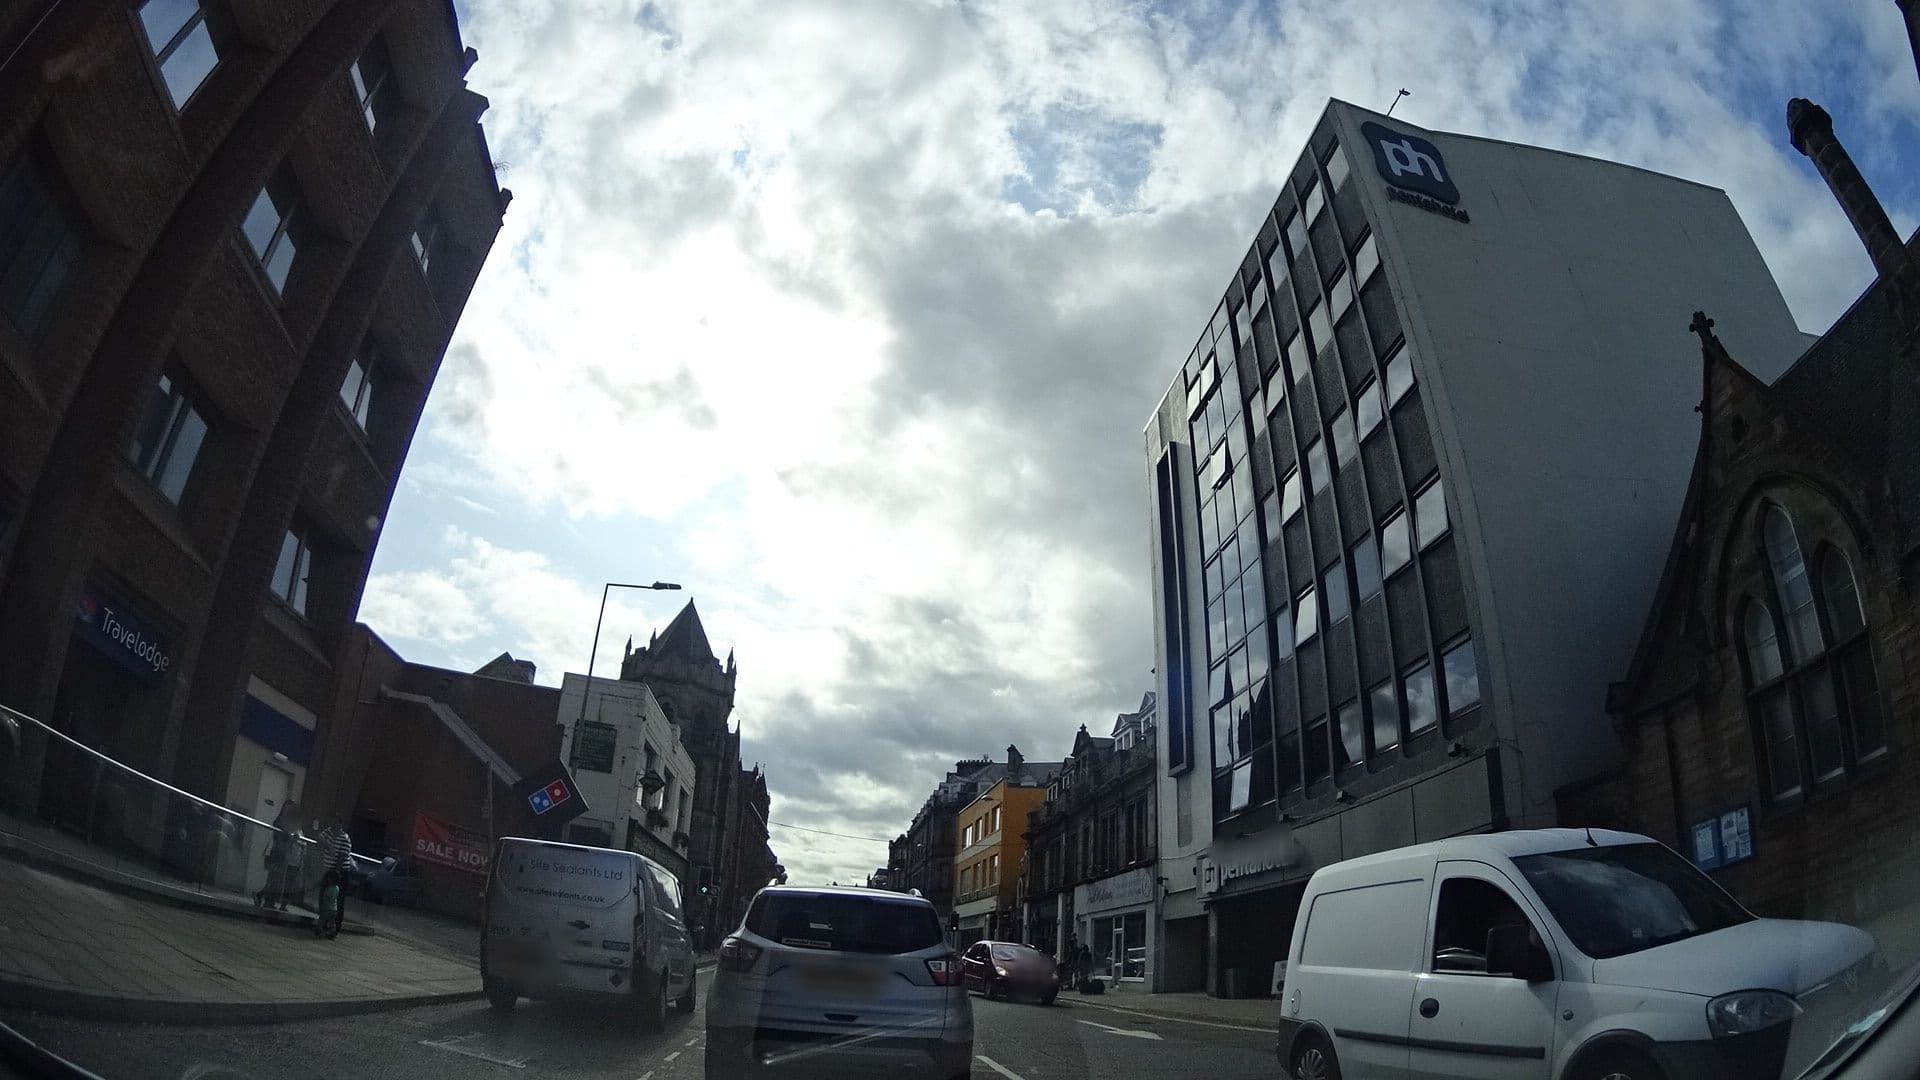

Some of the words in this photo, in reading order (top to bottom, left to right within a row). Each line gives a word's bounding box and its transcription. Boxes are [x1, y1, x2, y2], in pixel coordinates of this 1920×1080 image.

[102, 606, 170, 672] Travelodge
[416, 838, 455, 859] SALE
[604, 869, 623, 881] Ltd
